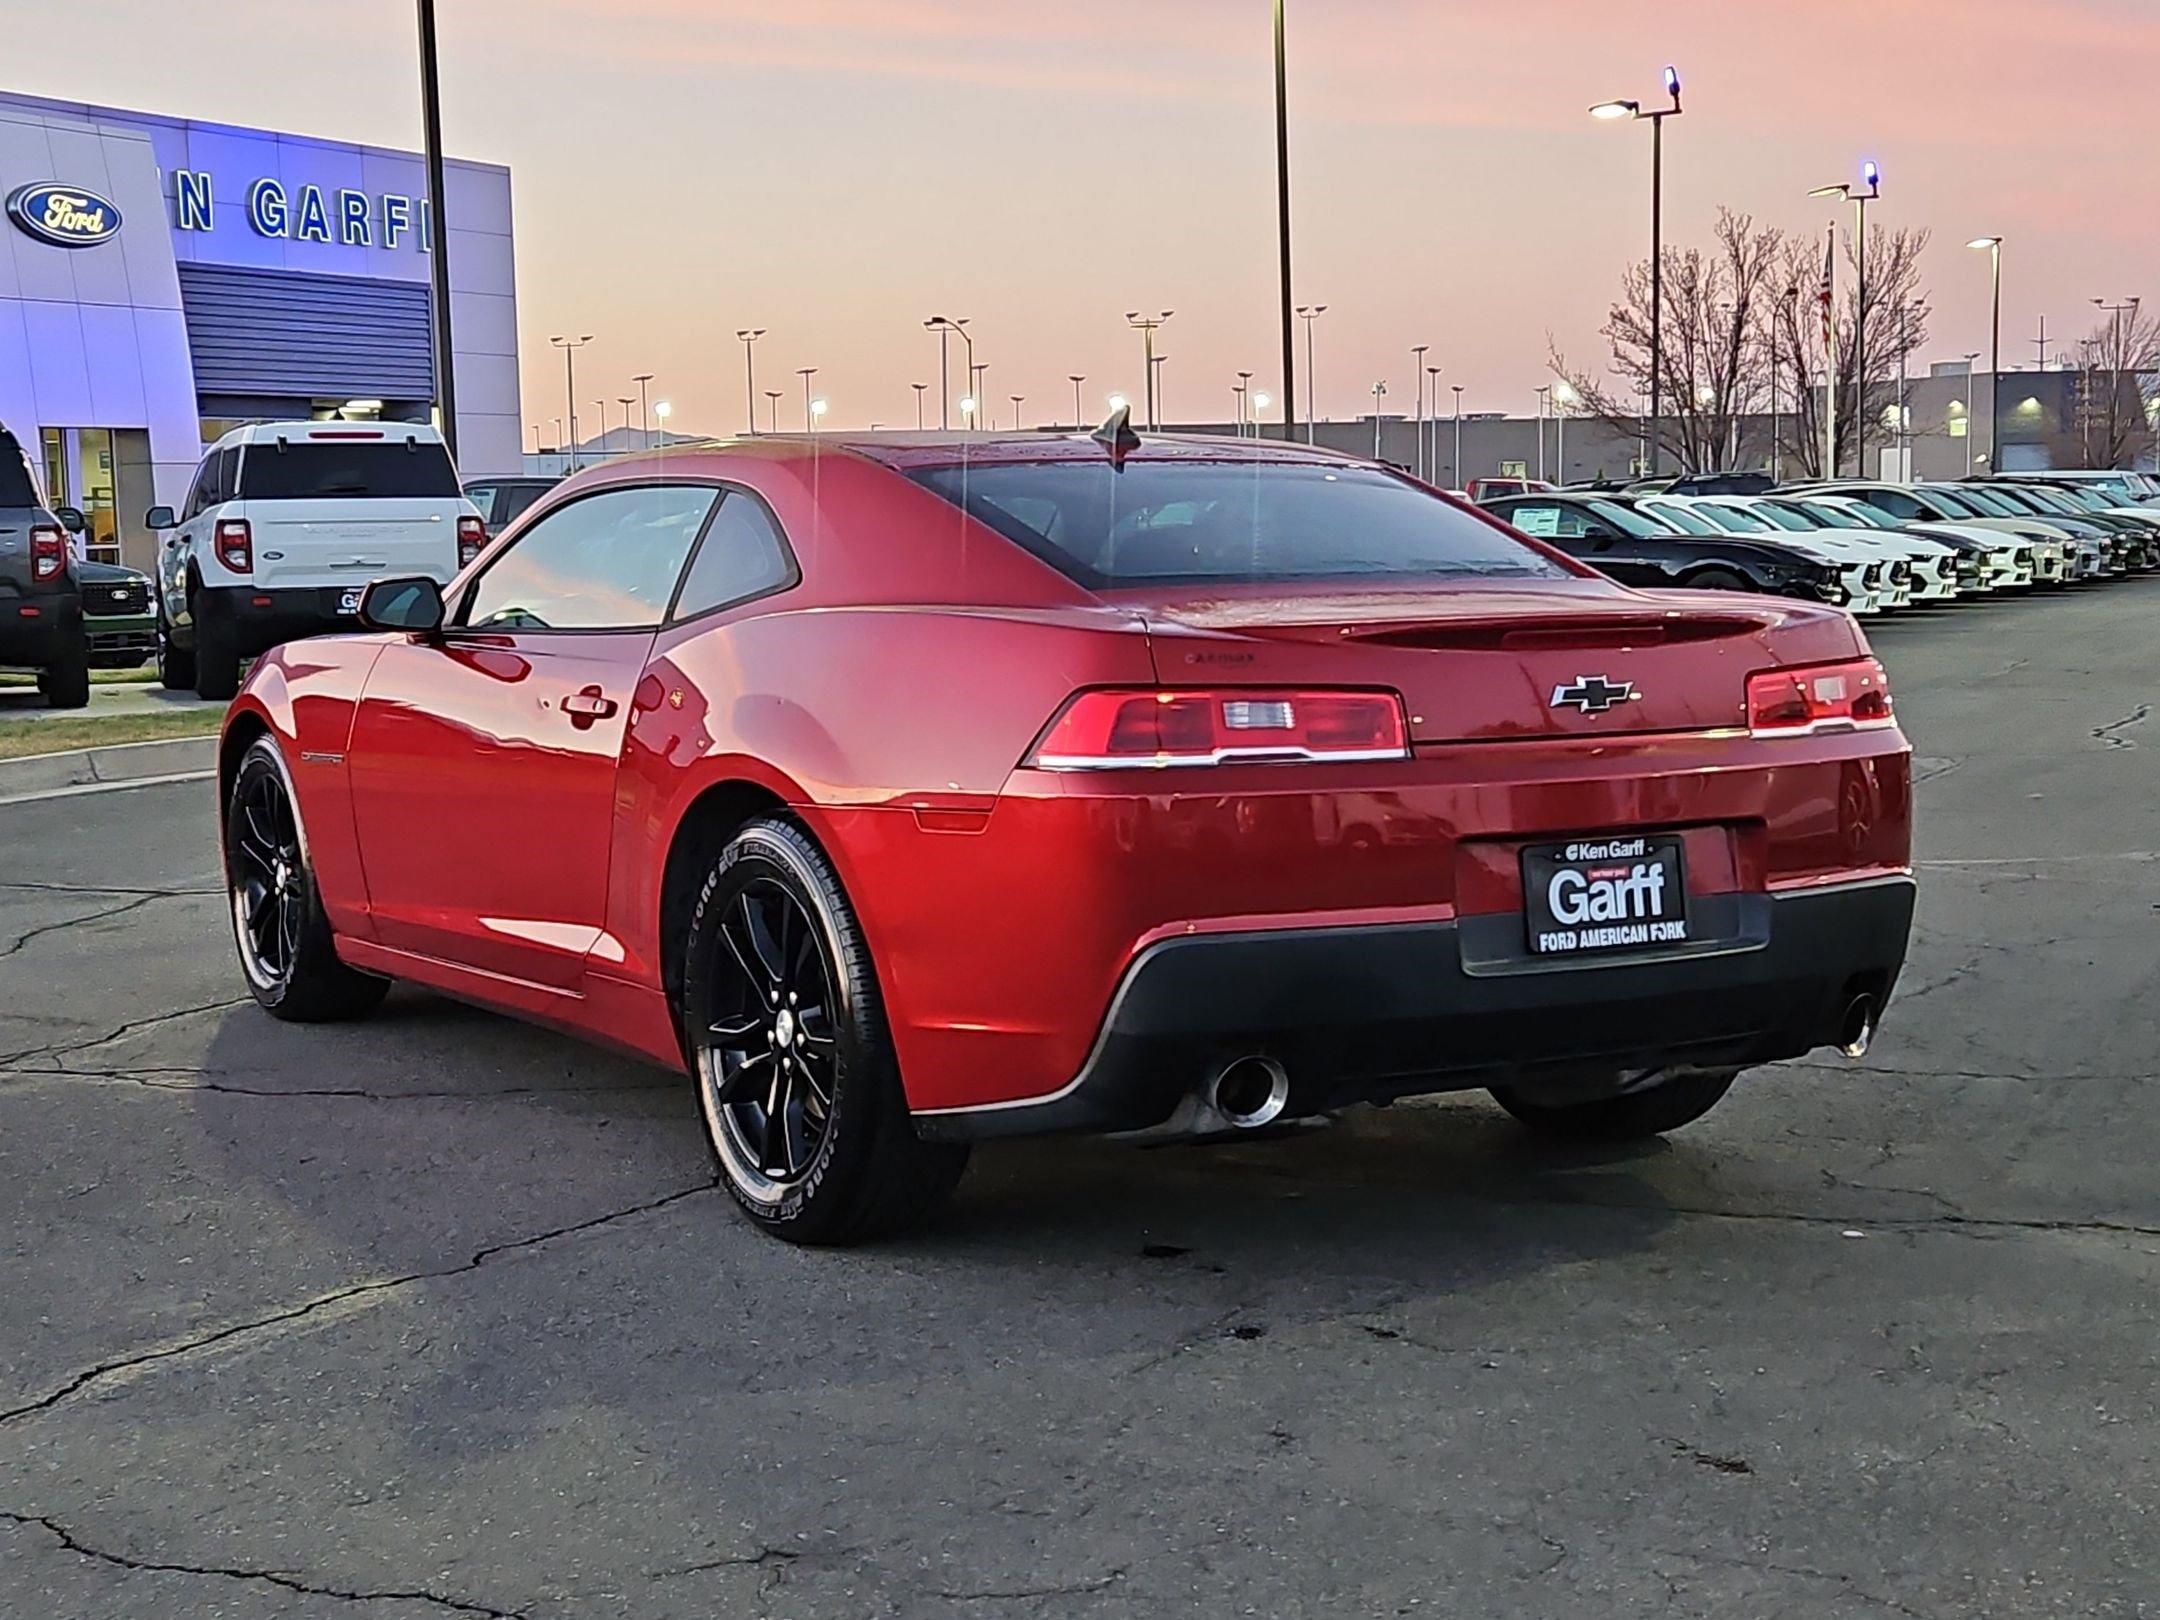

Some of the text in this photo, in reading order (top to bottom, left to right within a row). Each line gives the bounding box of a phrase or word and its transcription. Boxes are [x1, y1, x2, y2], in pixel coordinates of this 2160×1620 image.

[44, 194, 104, 233] Ford
[1579, 839, 1645, 860] Ken Garff
[1549, 863, 1664, 925] Garff
[1539, 920, 1687, 952] FORD AMERICAN FORK
